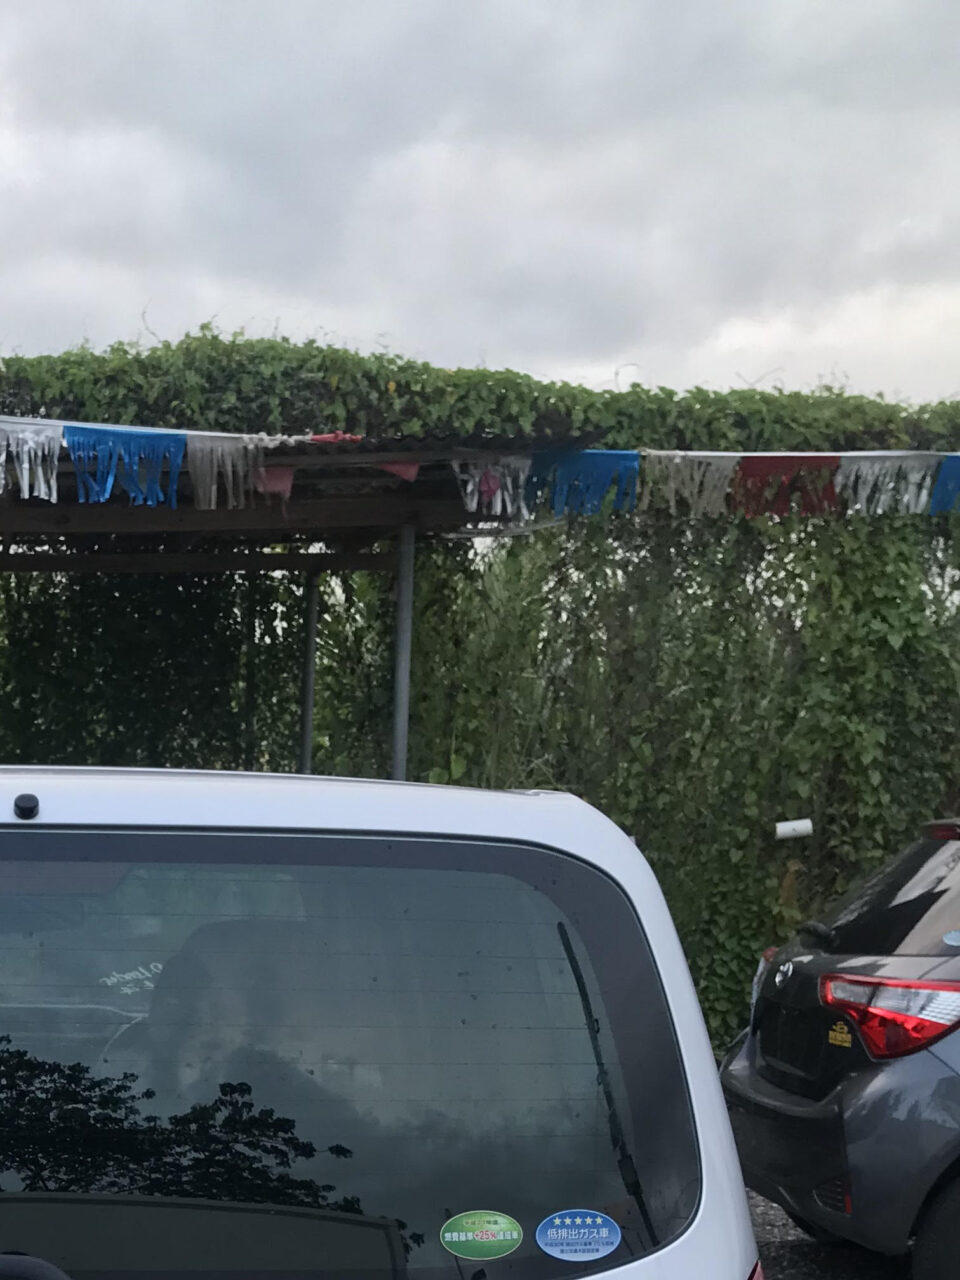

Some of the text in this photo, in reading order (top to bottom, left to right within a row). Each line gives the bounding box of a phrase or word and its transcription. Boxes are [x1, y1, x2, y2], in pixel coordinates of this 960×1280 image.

[547, 1228, 610, 1240] 低排出ガス車
